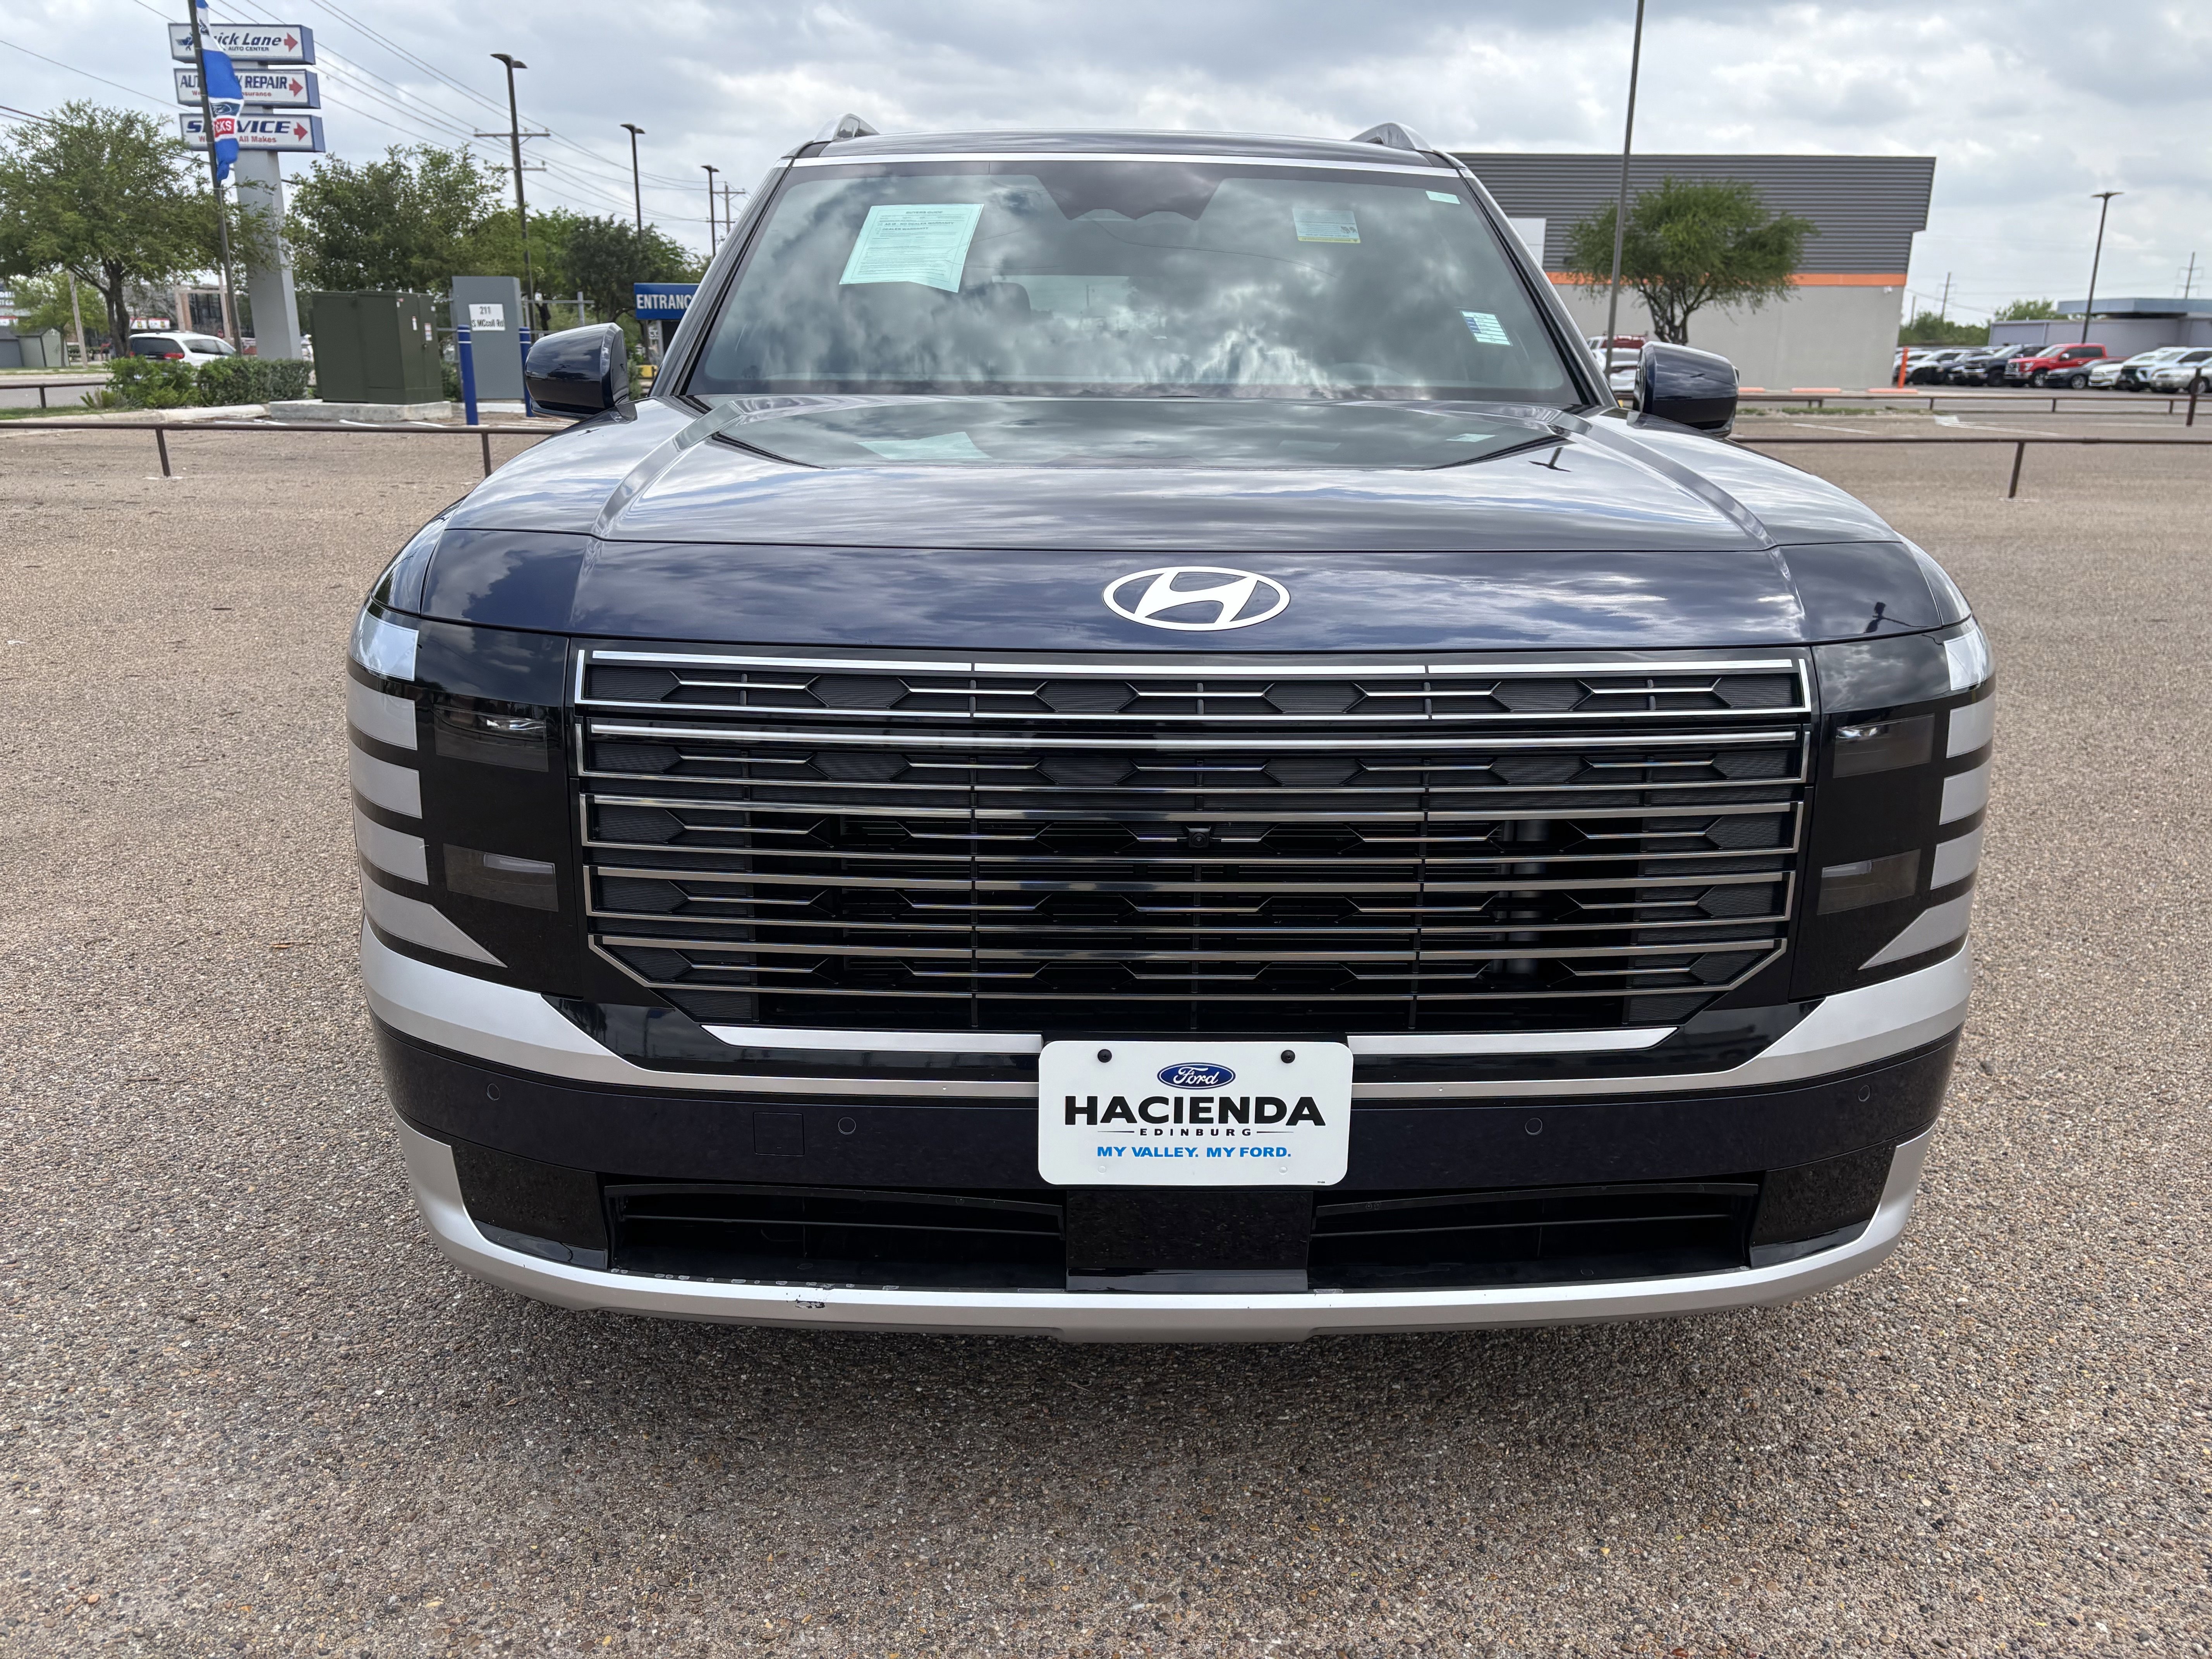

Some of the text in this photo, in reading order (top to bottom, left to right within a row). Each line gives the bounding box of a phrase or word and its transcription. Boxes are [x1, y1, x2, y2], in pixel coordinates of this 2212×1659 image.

[214, 32, 282, 46] ick Lane
[245, 76, 287, 89] REPAIR
[186, 120, 290, 133] SVICE
[636, 294, 694, 309] ENTRANC
[480, 306, 491, 314] 211
[1173, 1066, 1219, 1084] Ford
[1065, 1096, 1326, 1126] HACIENDA
[1140, 1128, 1252, 1137] EDINBURG
[1097, 1146, 1291, 1158] MY VALLEY. MY FORD.
